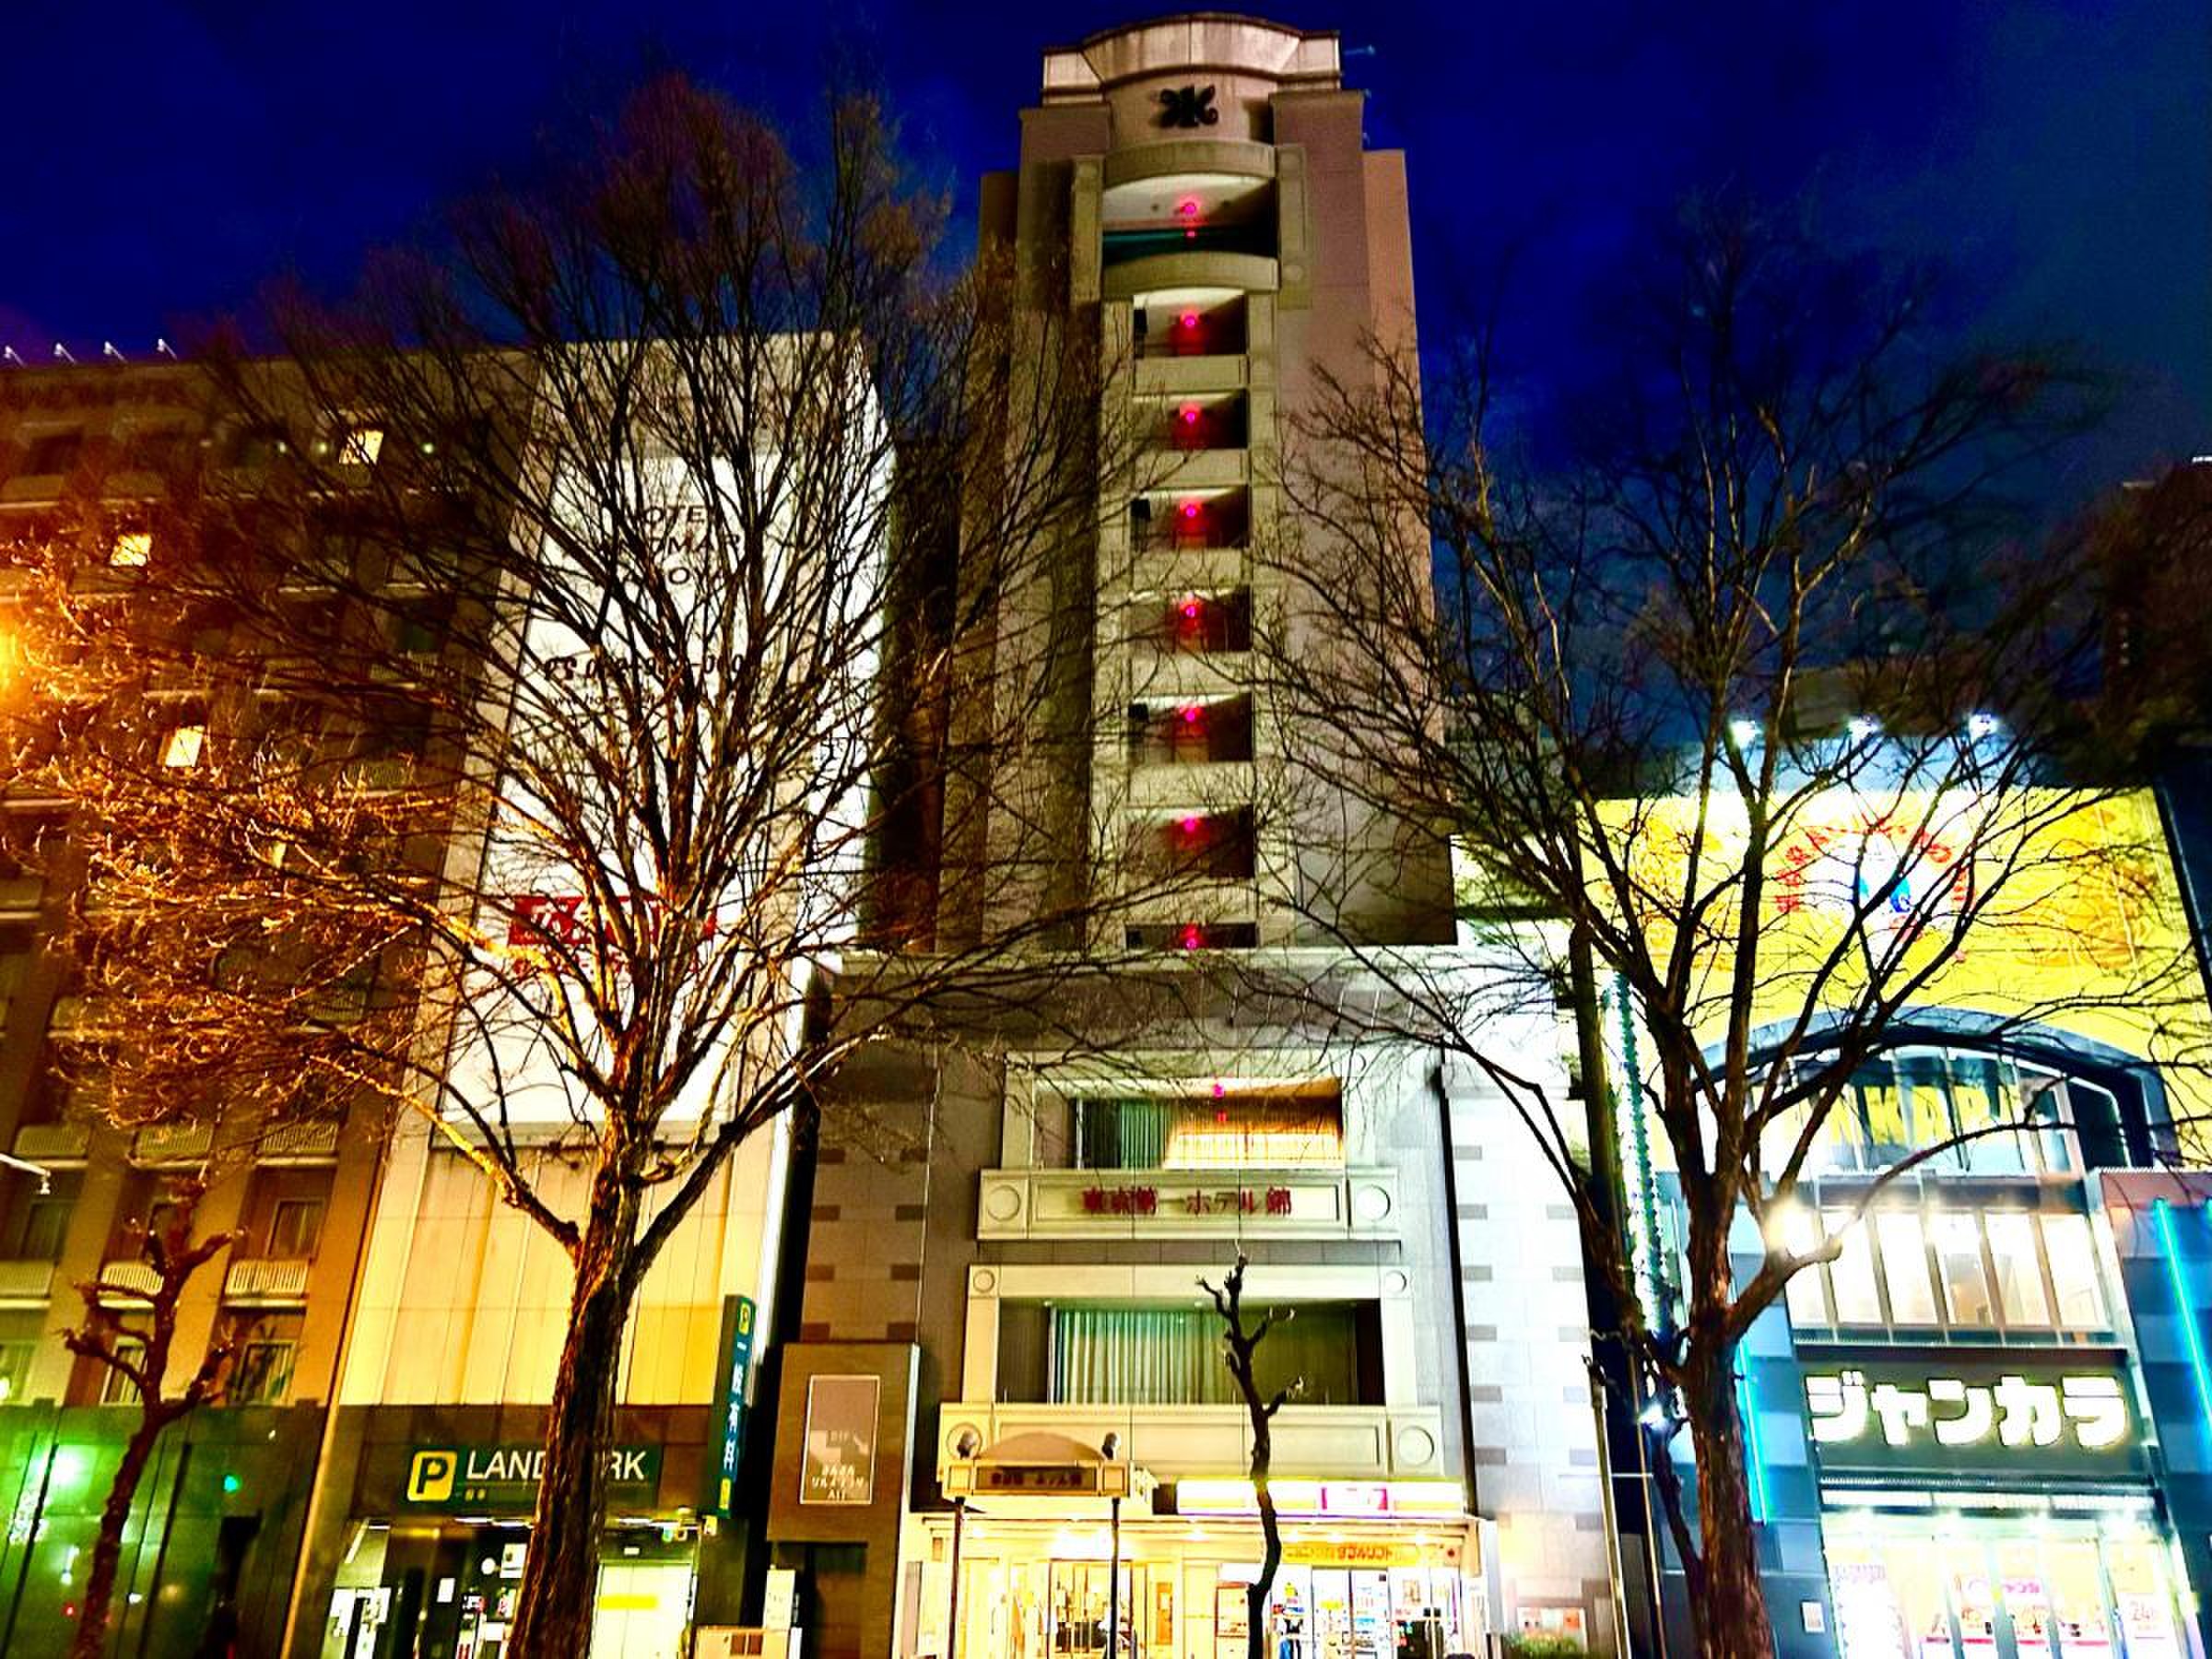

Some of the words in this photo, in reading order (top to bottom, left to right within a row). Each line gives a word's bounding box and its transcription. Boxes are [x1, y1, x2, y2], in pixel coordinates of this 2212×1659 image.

[1805, 1370, 2125, 1447] ジャンカラ
